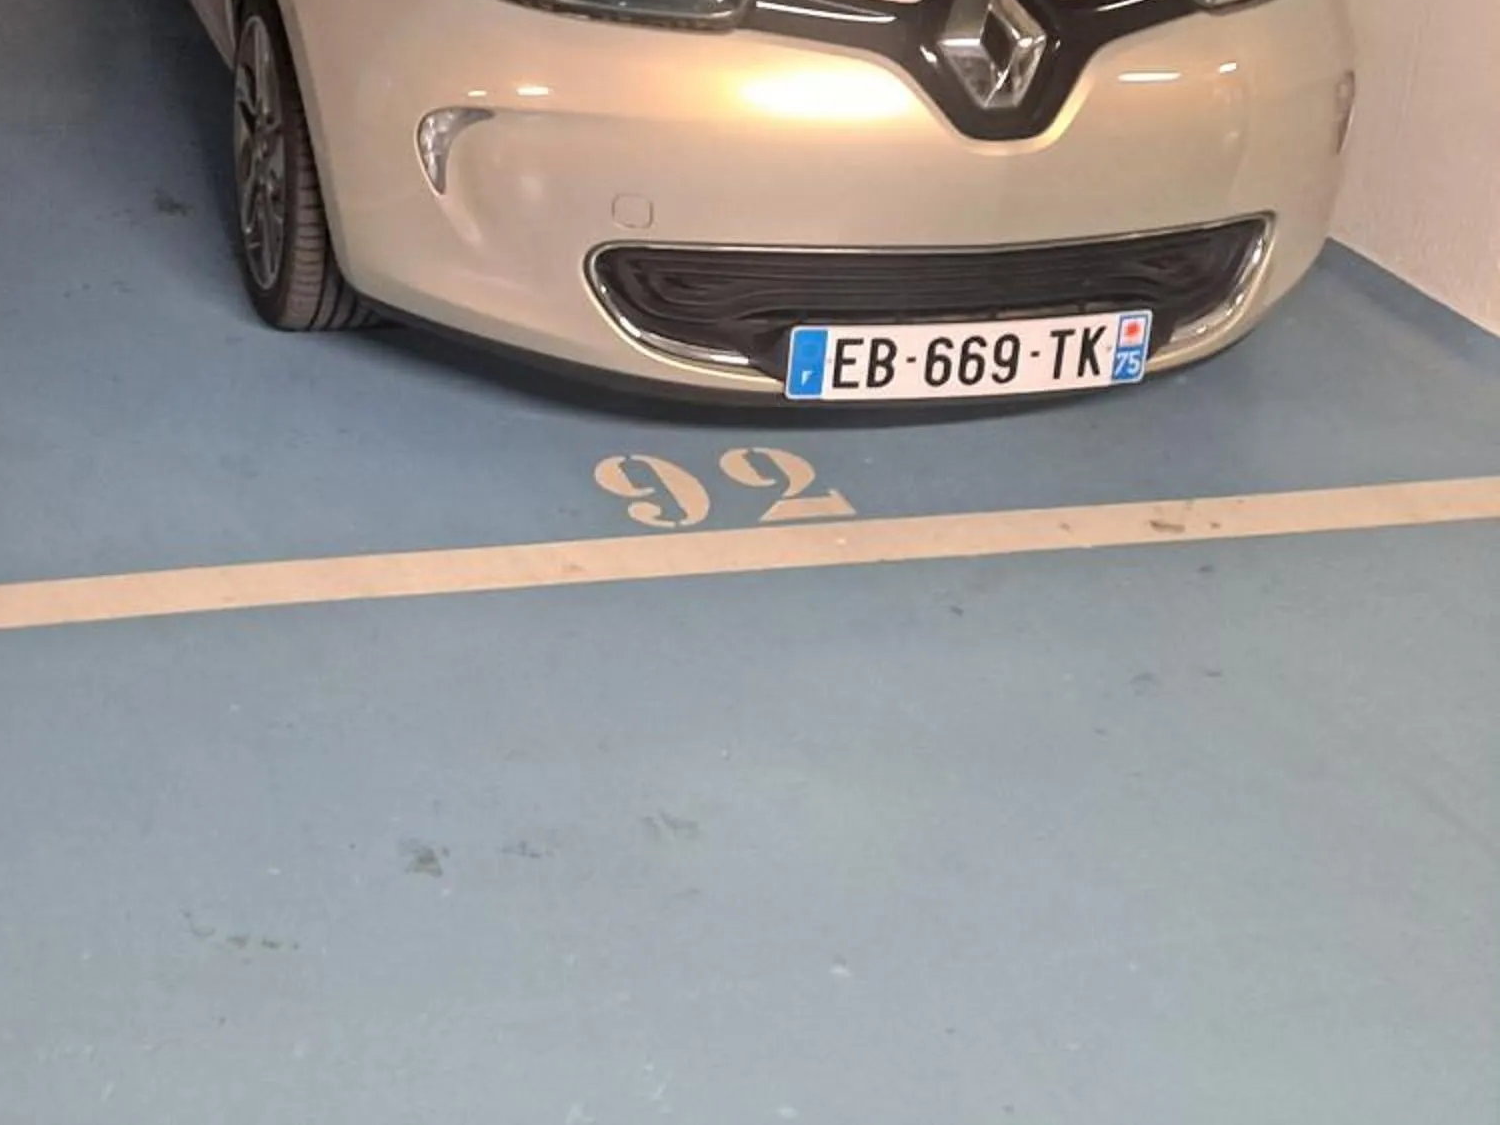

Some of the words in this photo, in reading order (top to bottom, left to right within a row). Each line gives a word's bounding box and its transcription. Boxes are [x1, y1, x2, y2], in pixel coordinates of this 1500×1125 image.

[831, 324, 1107, 390] EB-669-TK
[1114, 349, 1142, 376] 75
[593, 446, 857, 528] 92
